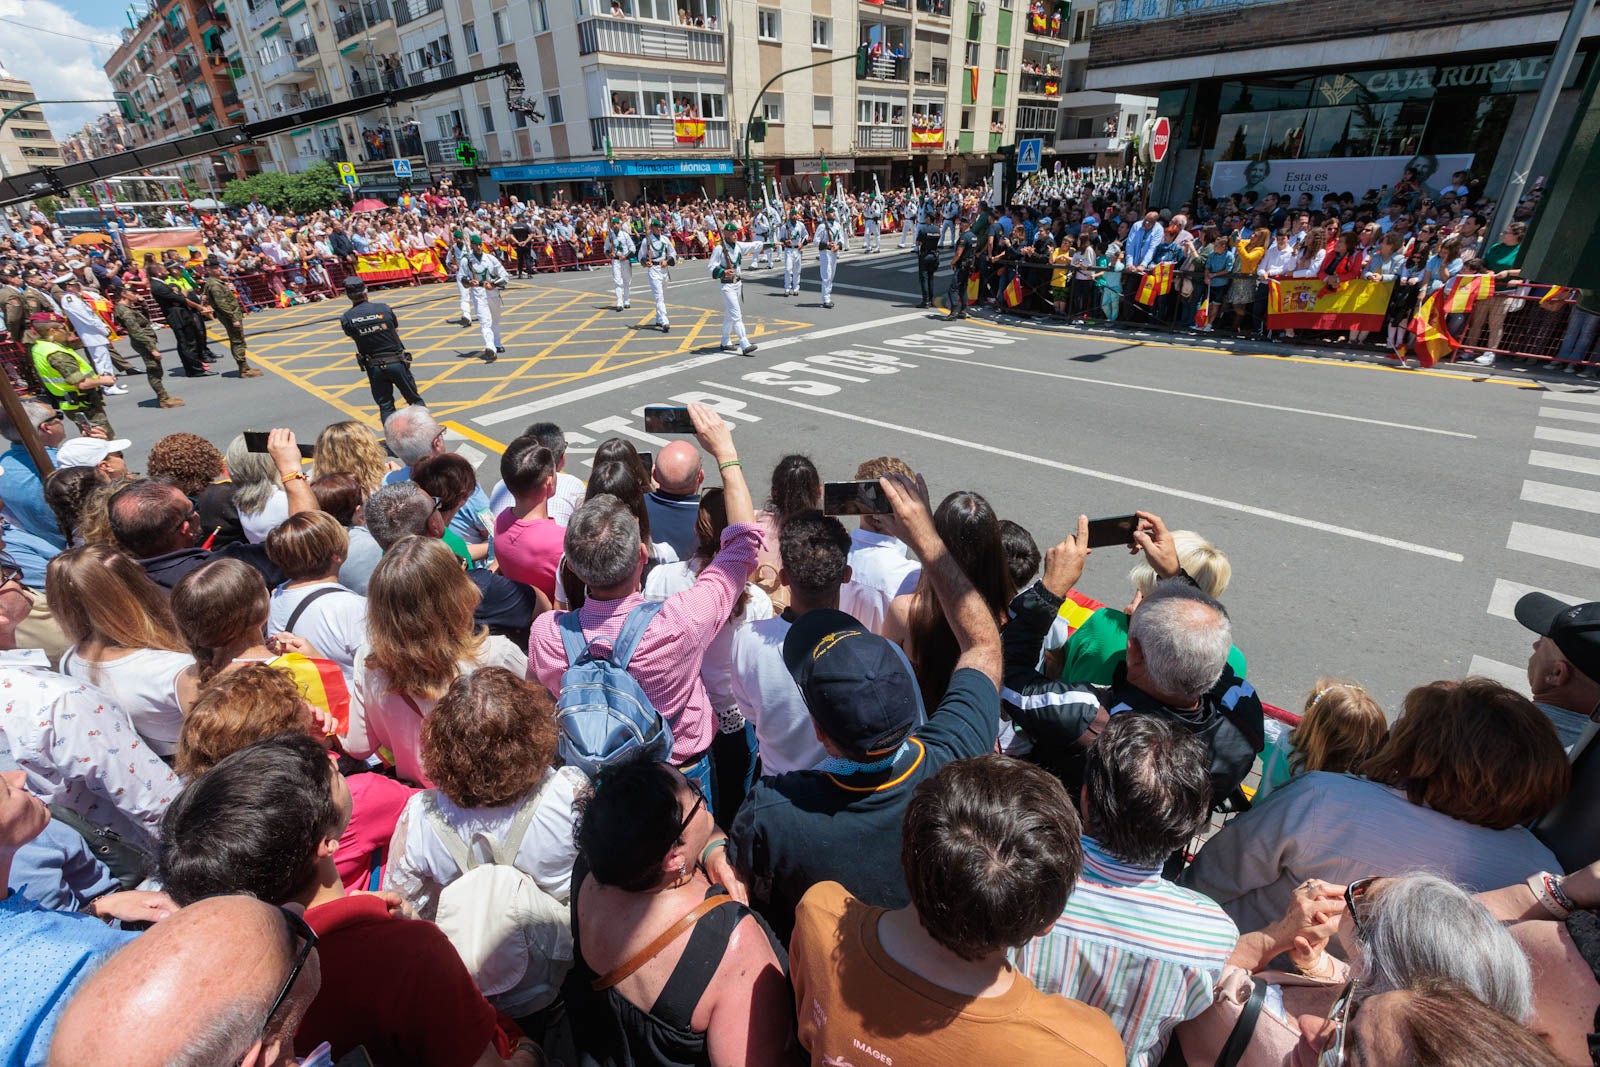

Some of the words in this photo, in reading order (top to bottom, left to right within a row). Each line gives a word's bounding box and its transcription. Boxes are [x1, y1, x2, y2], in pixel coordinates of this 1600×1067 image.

[1366, 68, 1433, 91] CAJA
[1437, 58, 1547, 86] RURAL
[1155, 135, 1167, 145] STOP
[635, 162, 675, 172] farmacia
[1285, 171, 1311, 182] Esta
[1314, 173, 1328, 181] es
[1283, 183, 1295, 192] tu
[883, 326, 1028, 355] STOP
[741, 349, 919, 396] STOP
[853, 1038, 893, 1066] IMAGES
